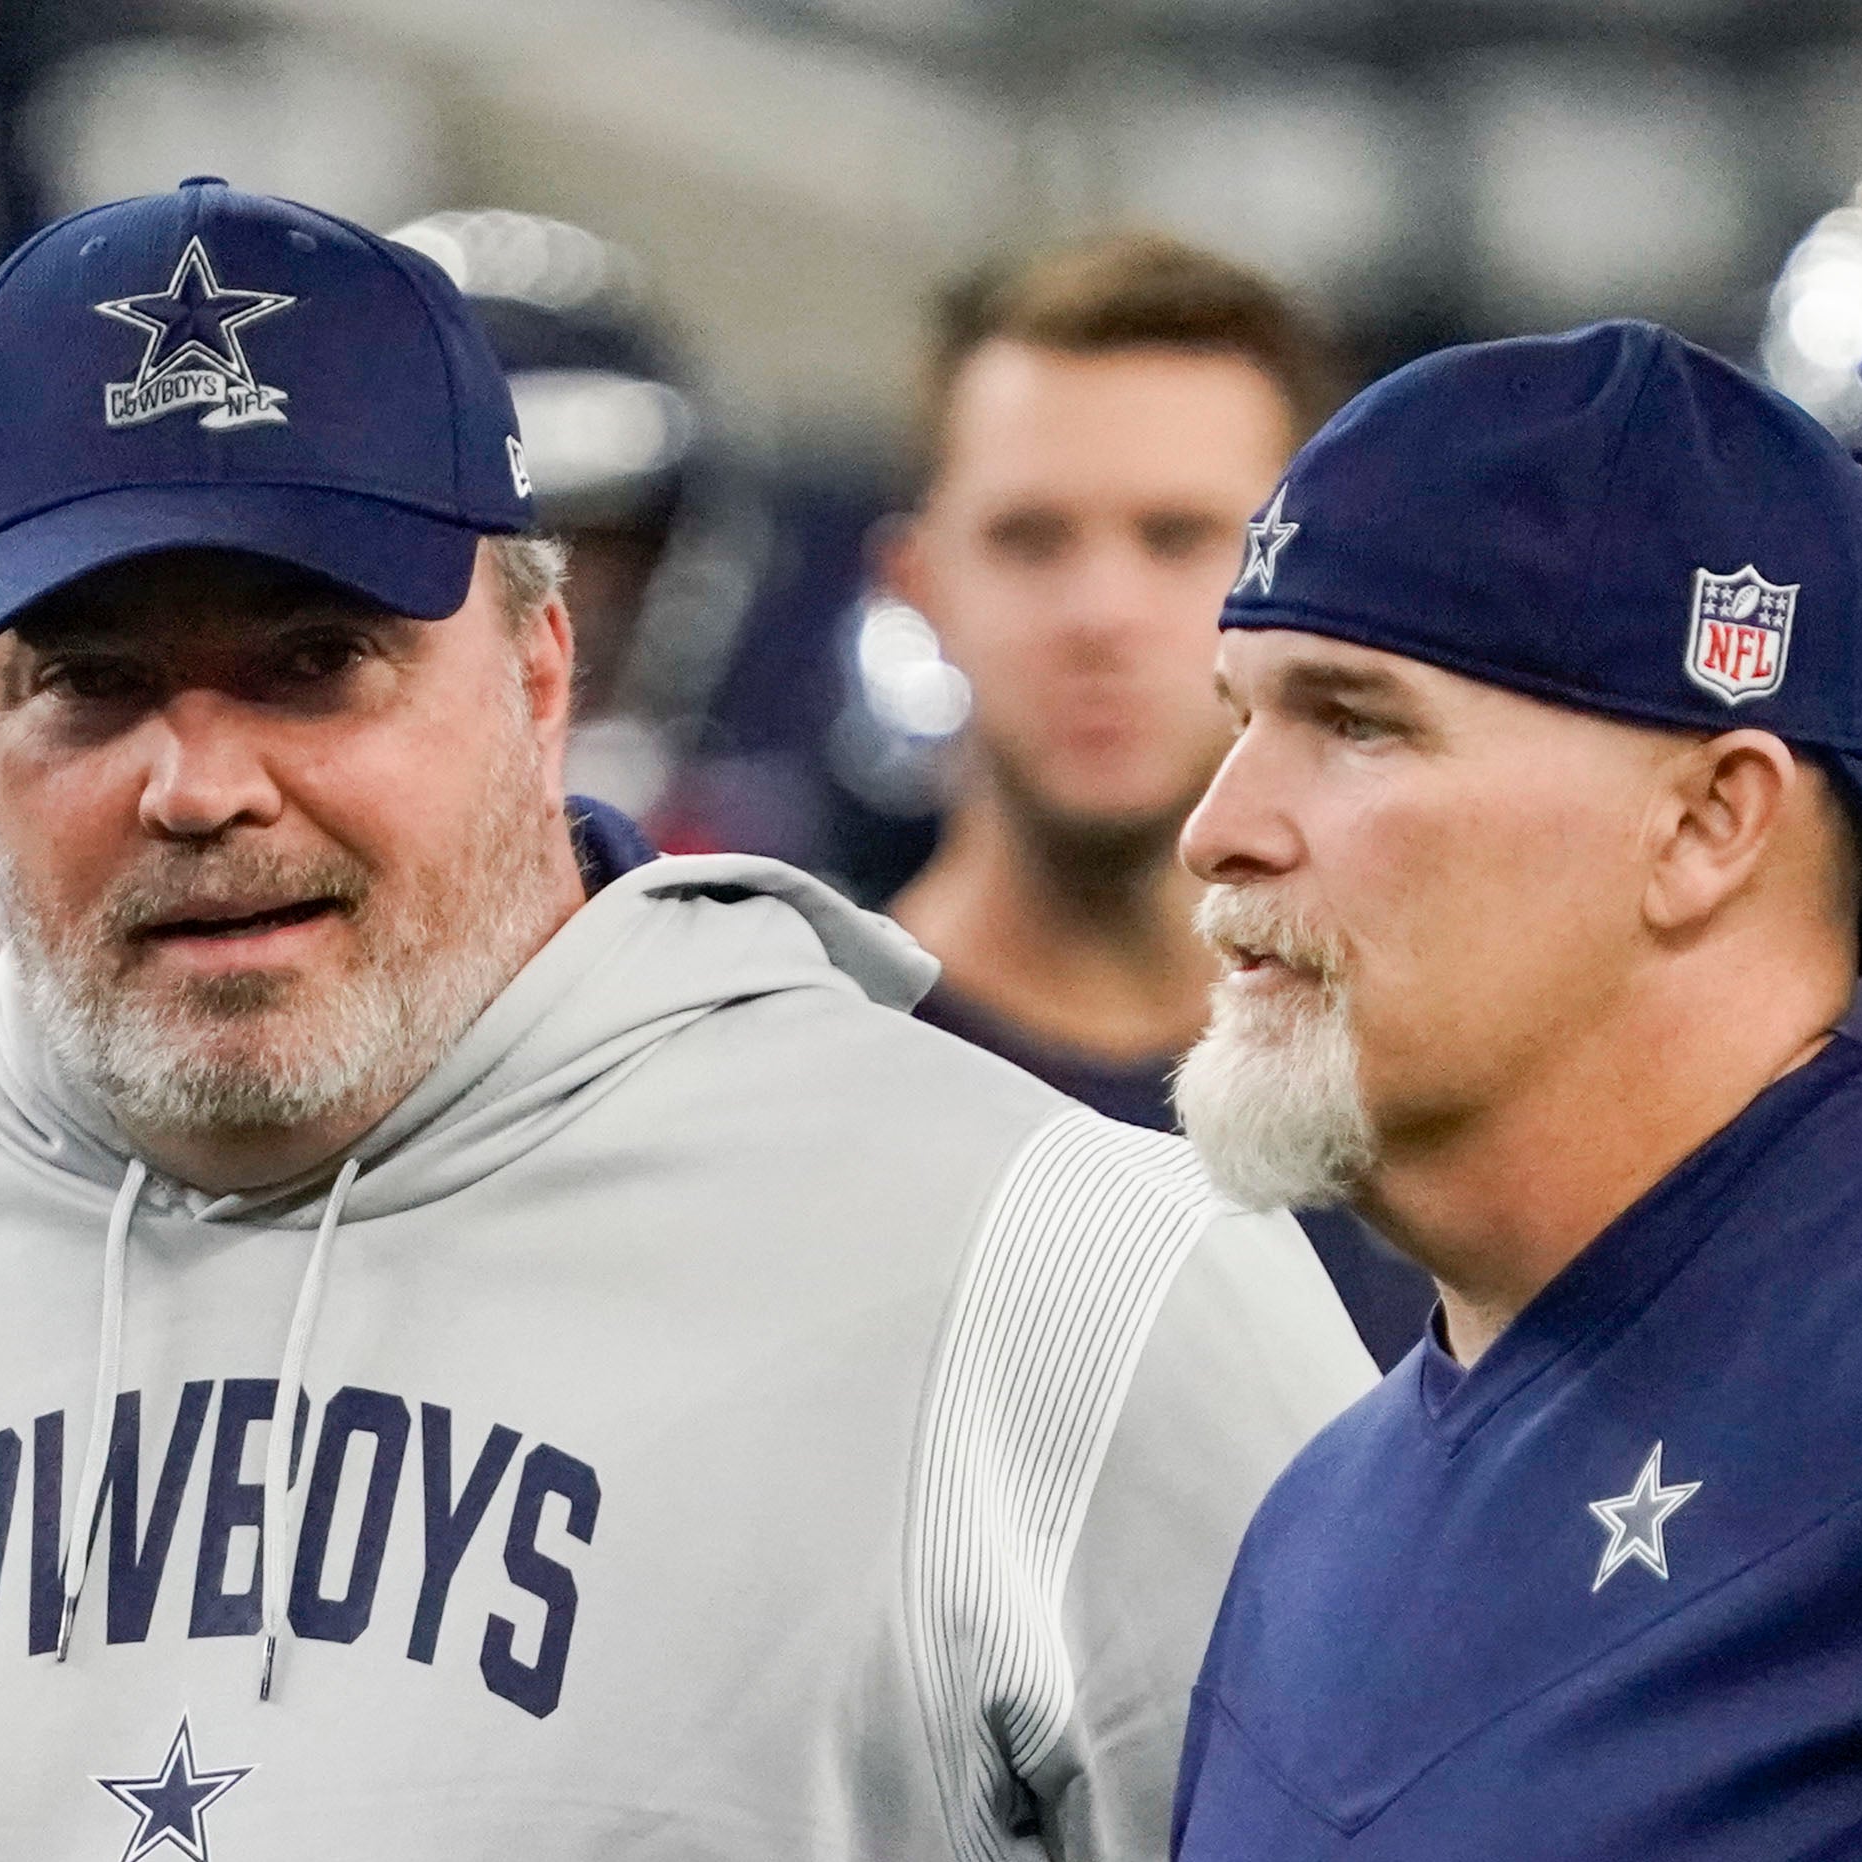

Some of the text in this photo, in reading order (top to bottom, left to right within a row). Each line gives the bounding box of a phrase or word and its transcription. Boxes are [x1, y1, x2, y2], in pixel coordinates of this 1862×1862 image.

[111, 374, 271, 419] COWBOYS NFC
[1704, 622, 1772, 681] NFL
